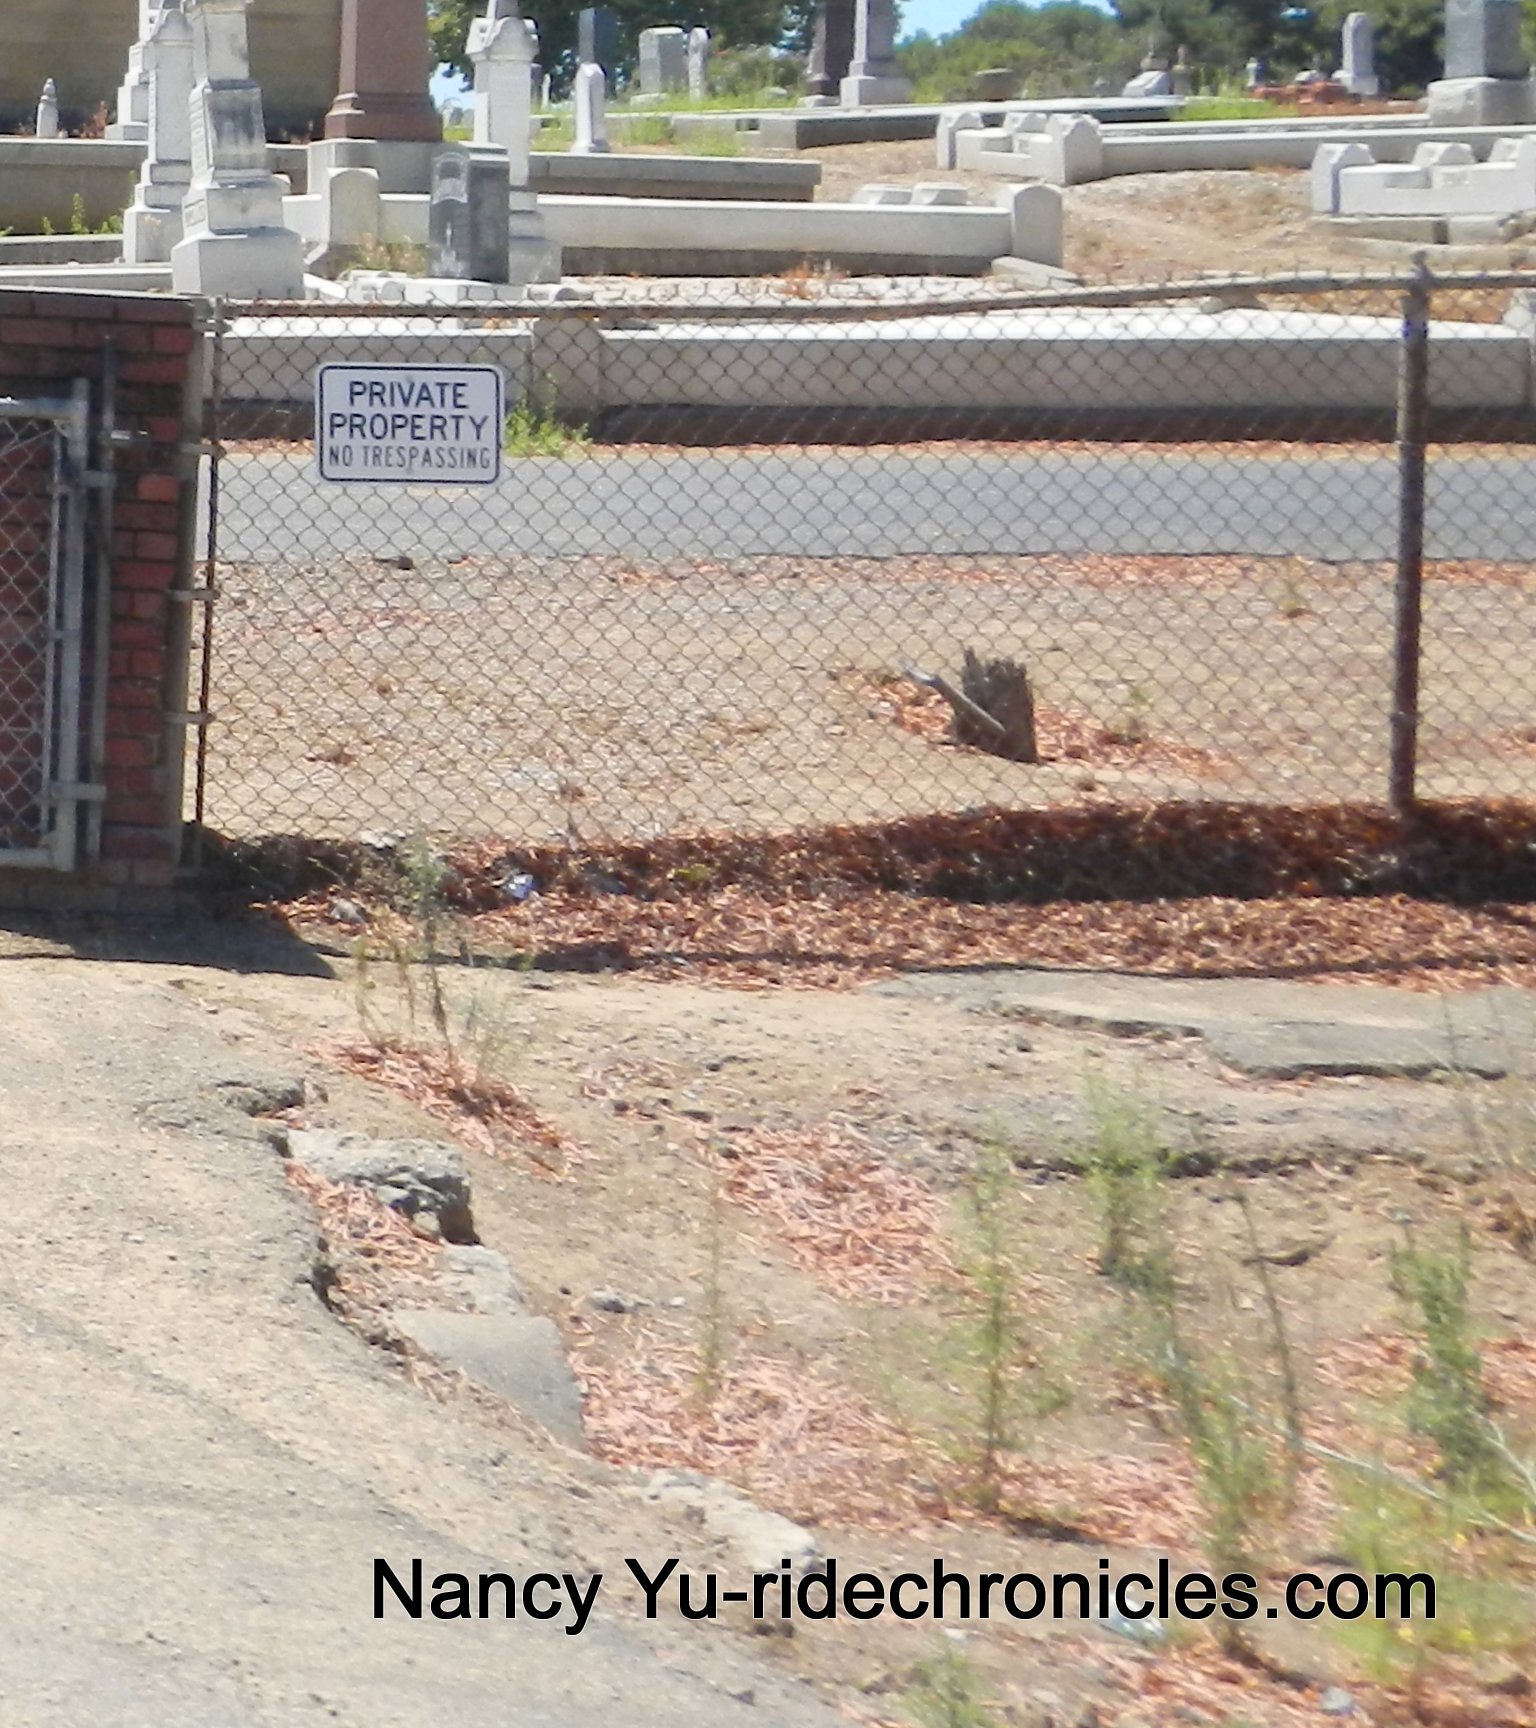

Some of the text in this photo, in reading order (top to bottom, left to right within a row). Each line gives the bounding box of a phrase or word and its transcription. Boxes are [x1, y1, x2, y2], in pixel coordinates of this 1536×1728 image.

[349, 381, 469, 409] PRIVATE
[329, 412, 489, 441] PROPERTY
[329, 444, 491, 470] NO TRESPASSING
